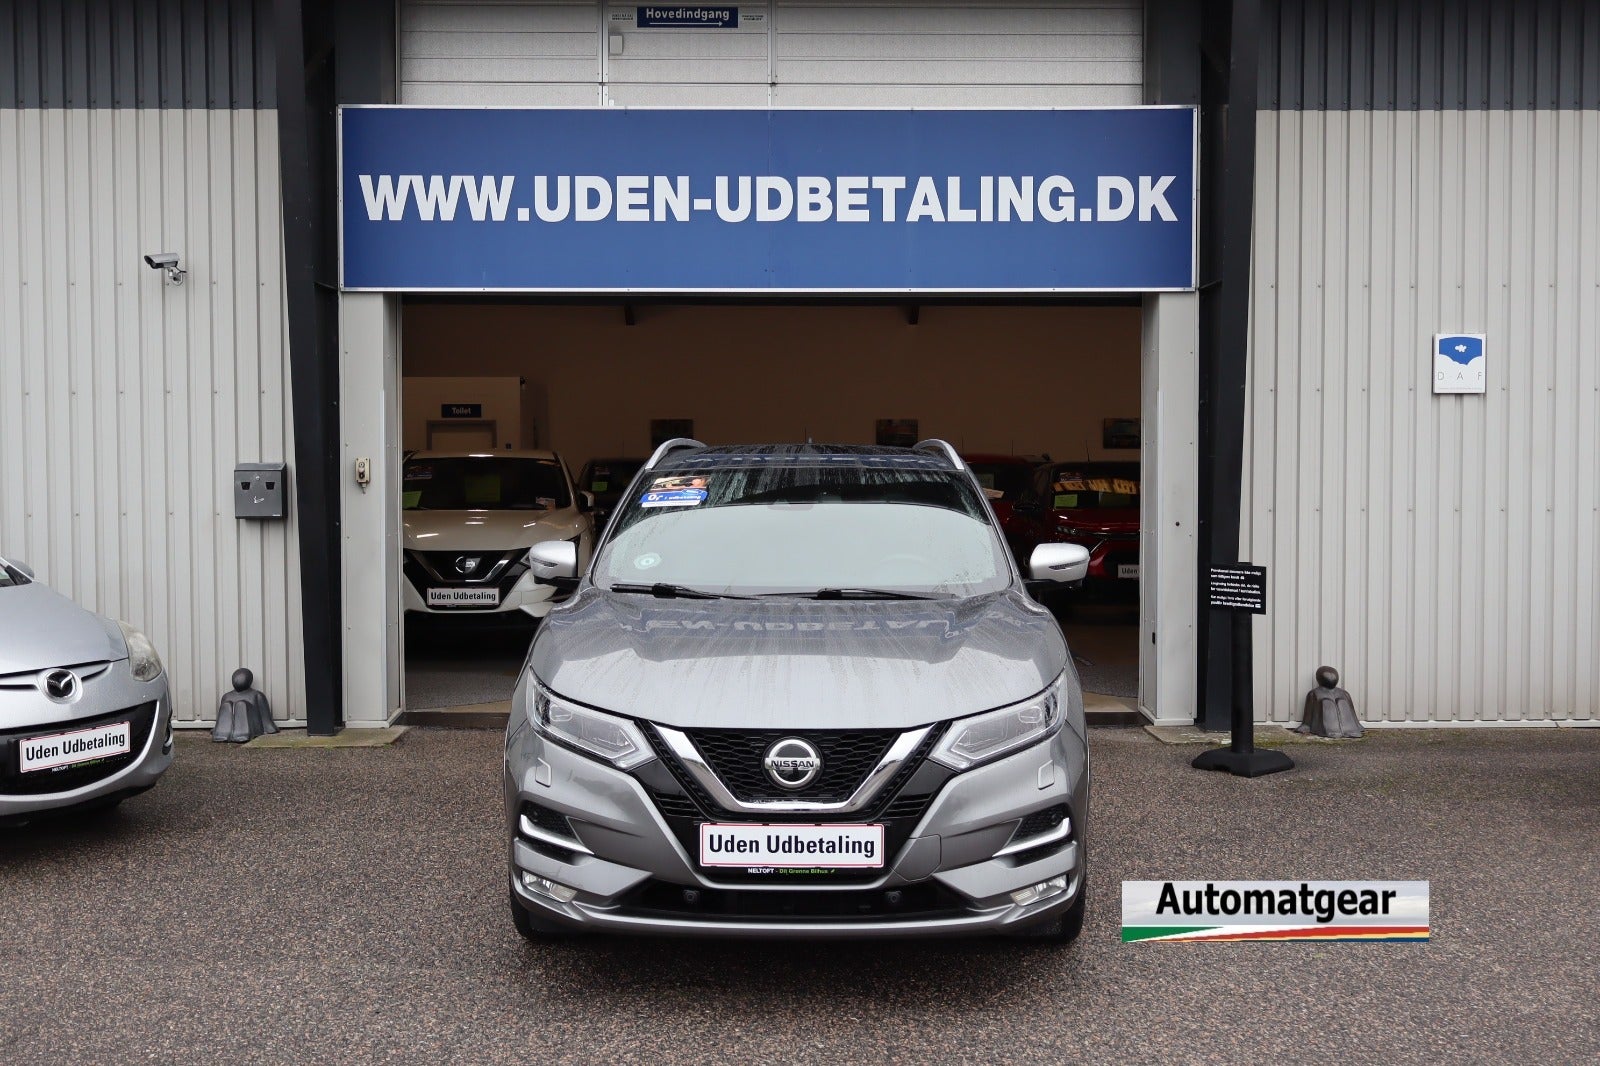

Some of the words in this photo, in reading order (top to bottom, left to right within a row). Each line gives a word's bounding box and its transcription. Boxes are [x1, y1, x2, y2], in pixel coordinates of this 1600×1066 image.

[646, 8, 729, 21] Hovedindgang
[358, 174, 1178, 223] WWW.UDEN-UDBETALING.DK
[451, 407, 472, 415] Toilet
[430, 592, 452, 600] Uden
[453, 591, 496, 602] Udbetaling
[26, 745, 59, 761] Uden
[63, 733, 125, 754] Udbetaling
[771, 759, 815, 768] NISSAN
[709, 834, 760, 853] Uden
[767, 834, 875, 858] Udbetaling
